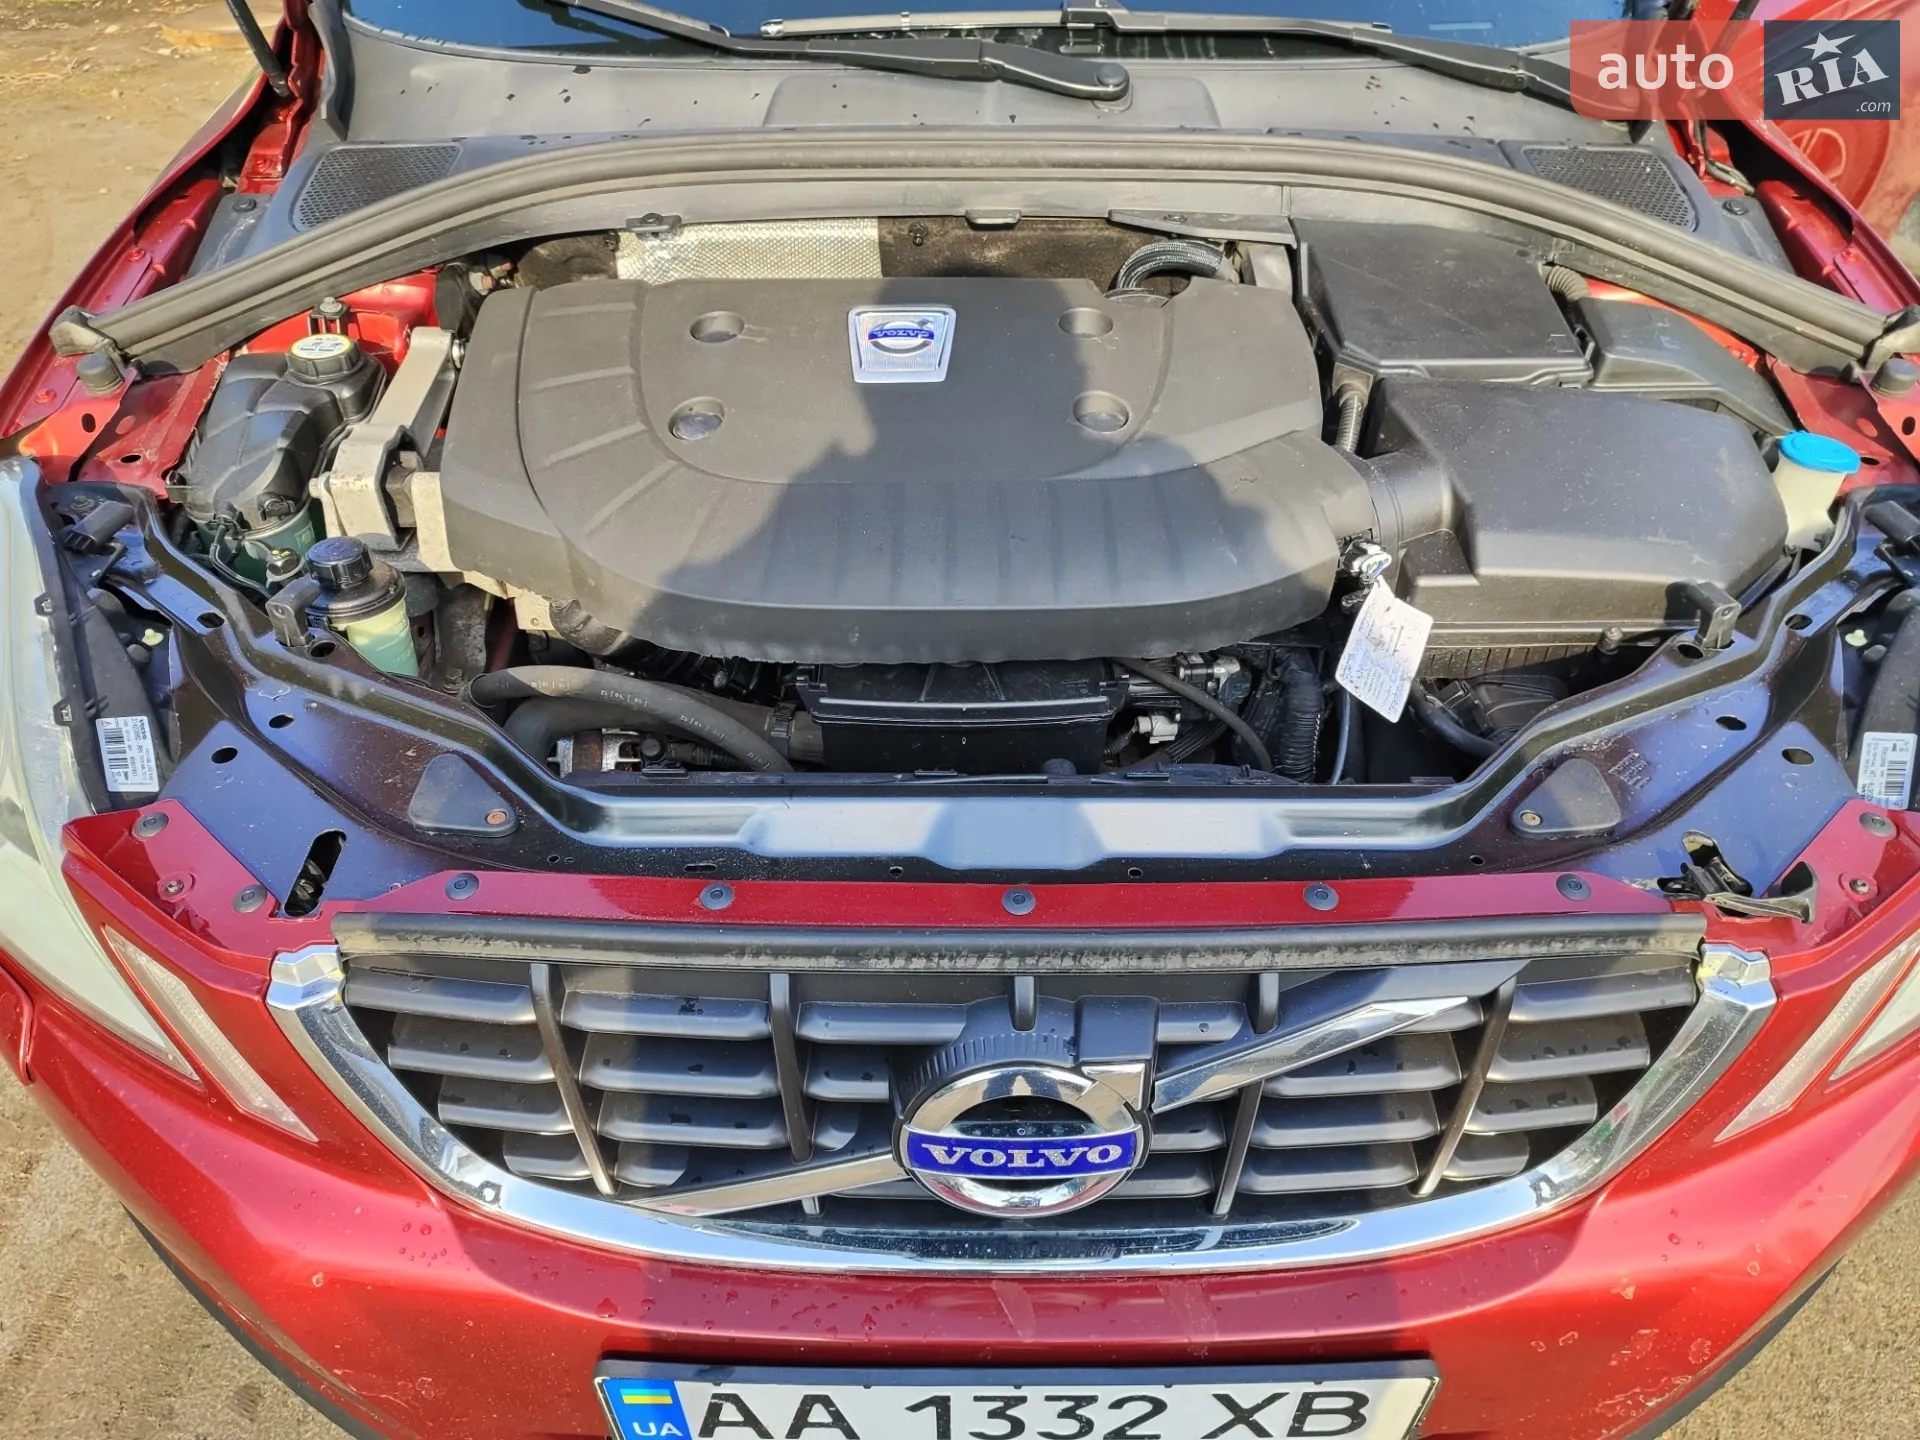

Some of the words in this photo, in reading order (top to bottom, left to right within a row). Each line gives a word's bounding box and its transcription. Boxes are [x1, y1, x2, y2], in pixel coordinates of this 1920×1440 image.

[873, 329, 930, 338] VOLVO
[921, 1144, 1122, 1168] VOLVO
[698, 1392, 861, 1440] AA
[905, 1395, 1168, 1440] 1332
[1200, 1391, 1370, 1440] XB
[632, 1421, 683, 1437] UA
